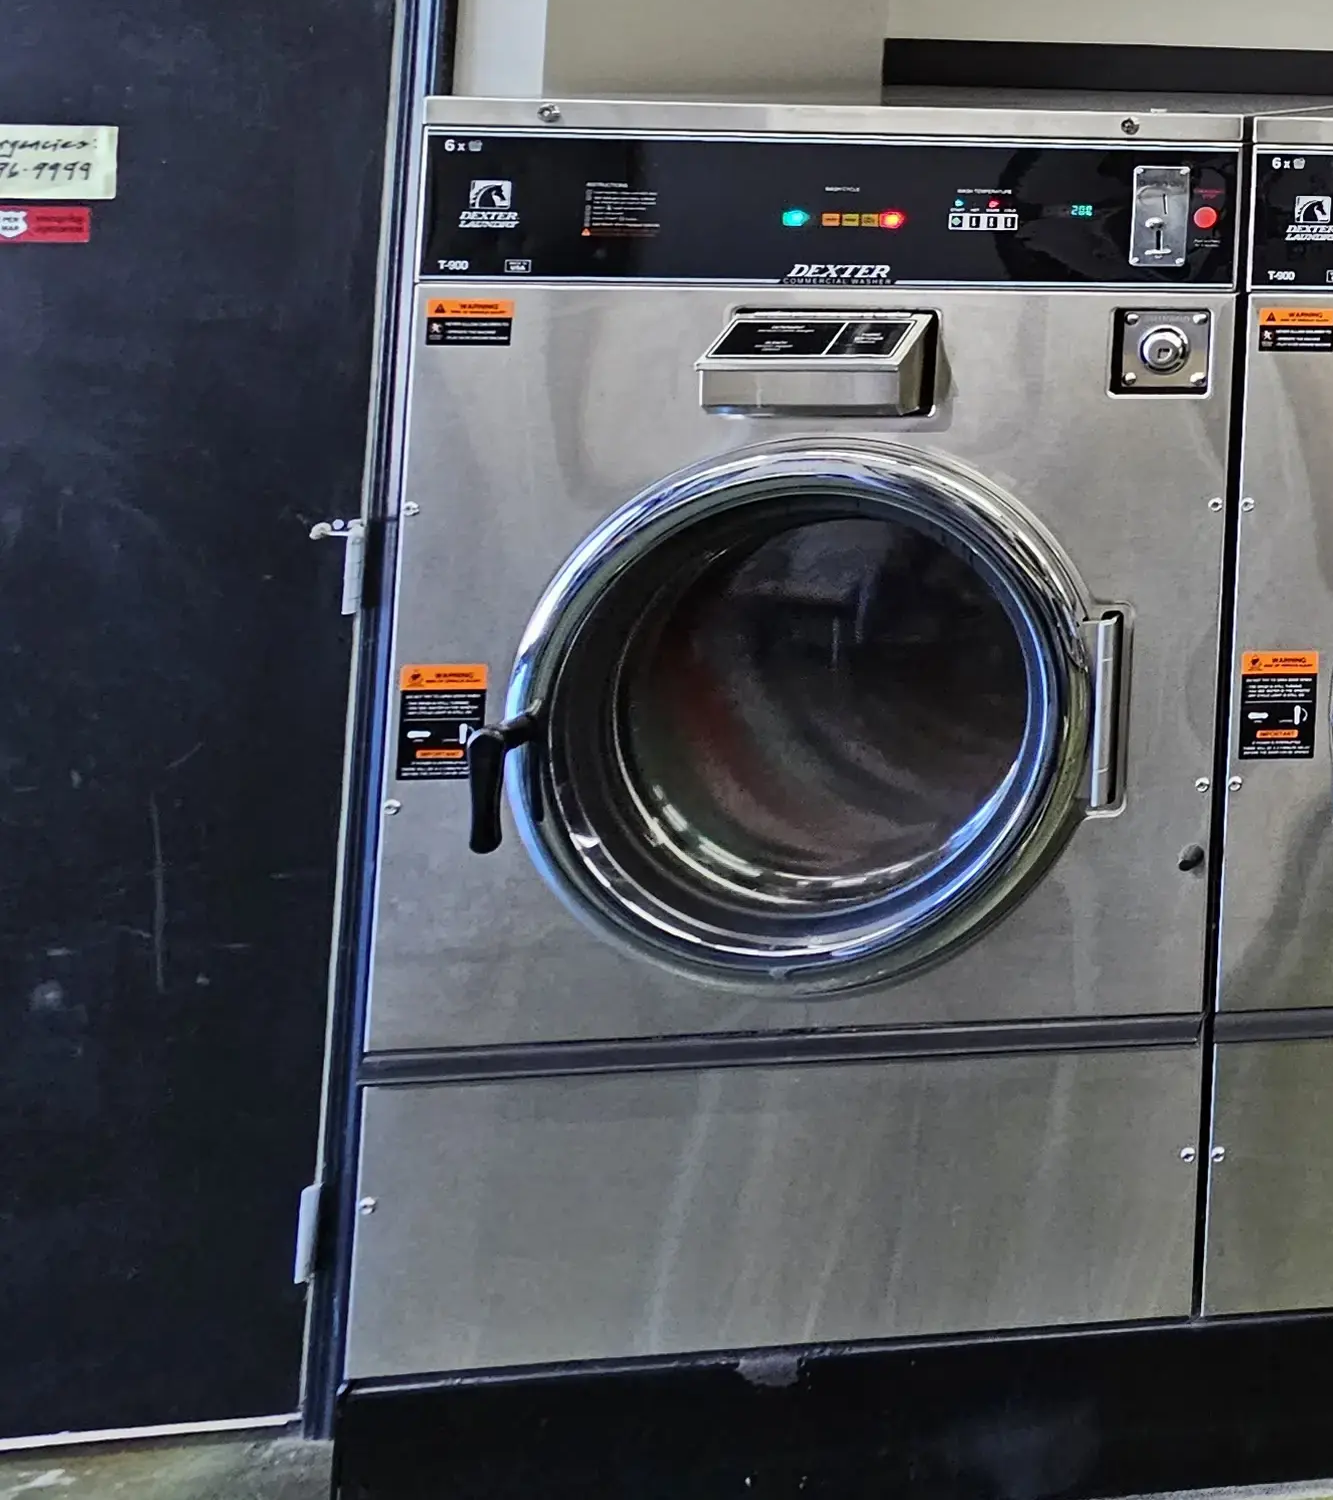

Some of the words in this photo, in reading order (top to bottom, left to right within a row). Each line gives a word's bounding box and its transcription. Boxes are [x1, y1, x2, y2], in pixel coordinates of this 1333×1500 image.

[444, 139, 455, 152] 6
[1272, 157, 1281, 169] 6
[459, 211, 518, 220] DEXTER
[787, 264, 891, 278] DEXTER
